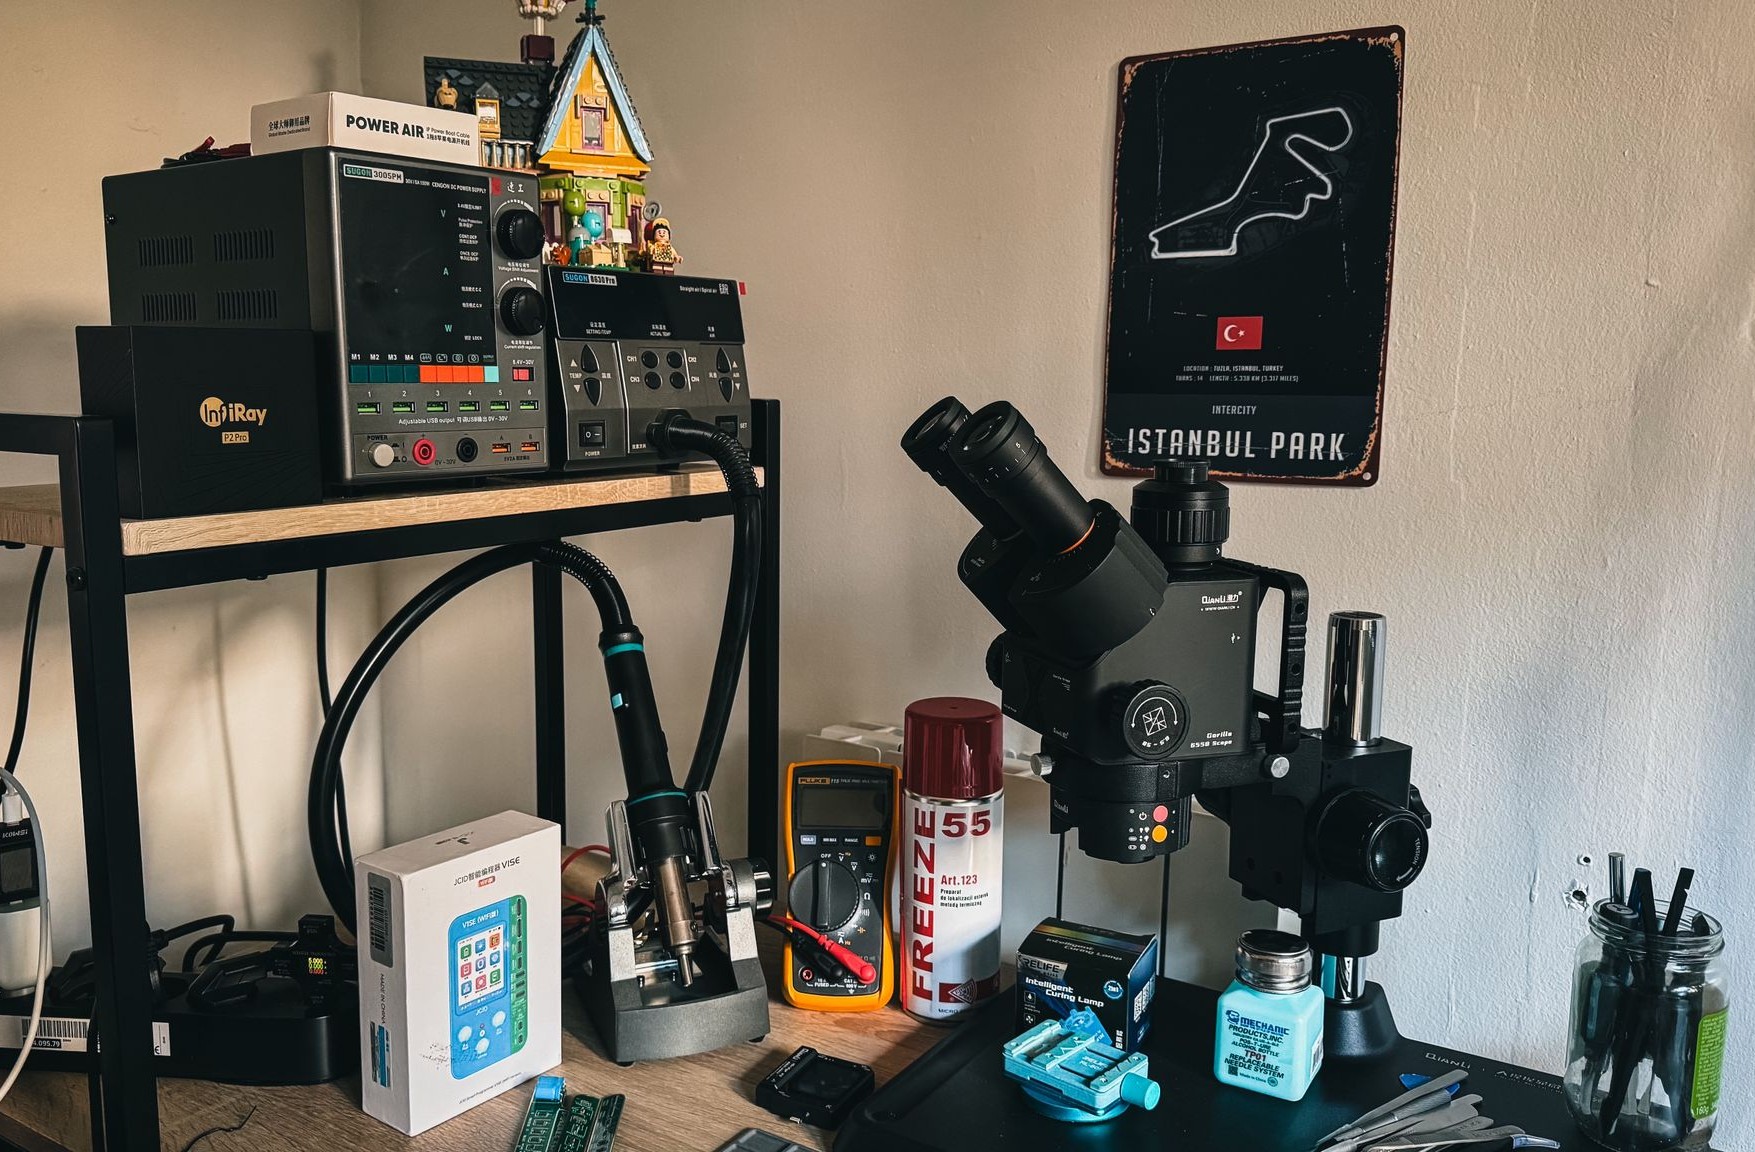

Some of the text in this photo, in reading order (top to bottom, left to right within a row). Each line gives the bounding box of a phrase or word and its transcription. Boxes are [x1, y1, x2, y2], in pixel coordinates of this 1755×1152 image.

[346, 114, 424, 138] POWER AIR
[431, 127, 445, 135] Power
[346, 167, 372, 177] SUGON
[440, 209, 446, 217] V
[443, 267, 449, 276] A
[564, 273, 588, 282] SUGON
[444, 324, 453, 333] W
[1212, 405, 1257, 415] INTERCITY
[398, 417, 426, 425] Adjustable
[426, 416, 438, 424] USB
[438, 416, 455, 424] output
[223, 433, 248, 442] P2 Pro
[1128, 428, 1346, 462] ISTANBUL PARK
[1206, 731, 1233, 740] Gorilla
[1211, 739, 1233, 748] Scope
[941, 810, 991, 838] 55
[860, 876, 872, 884] mV
[940, 874, 978, 886] Art.123
[912, 807, 935, 1002] FREEZE
[838, 937, 844, 945] A
[1046, 938, 1094, 951] Intelligent
[1064, 945, 1095, 955] Curing
[1022, 958, 1060, 974] RELIFE
[1025, 976, 1074, 994] Intelligent
[1045, 988, 1105, 1008] Curing Lamp
[1240, 1016, 1290, 1036] MECHANIC
[1231, 1040, 1257, 1052] ALCOHOL
[1257, 1047, 1280, 1058] BOTTLE
[1244, 1048, 1267, 1062] TP01
[1229, 1052, 1280, 1072] REPLACEABLE
[1425, 1052, 1471, 1070] QIANLI
[1224, 1057, 1285, 1080] NEEDLE SYSTEM
